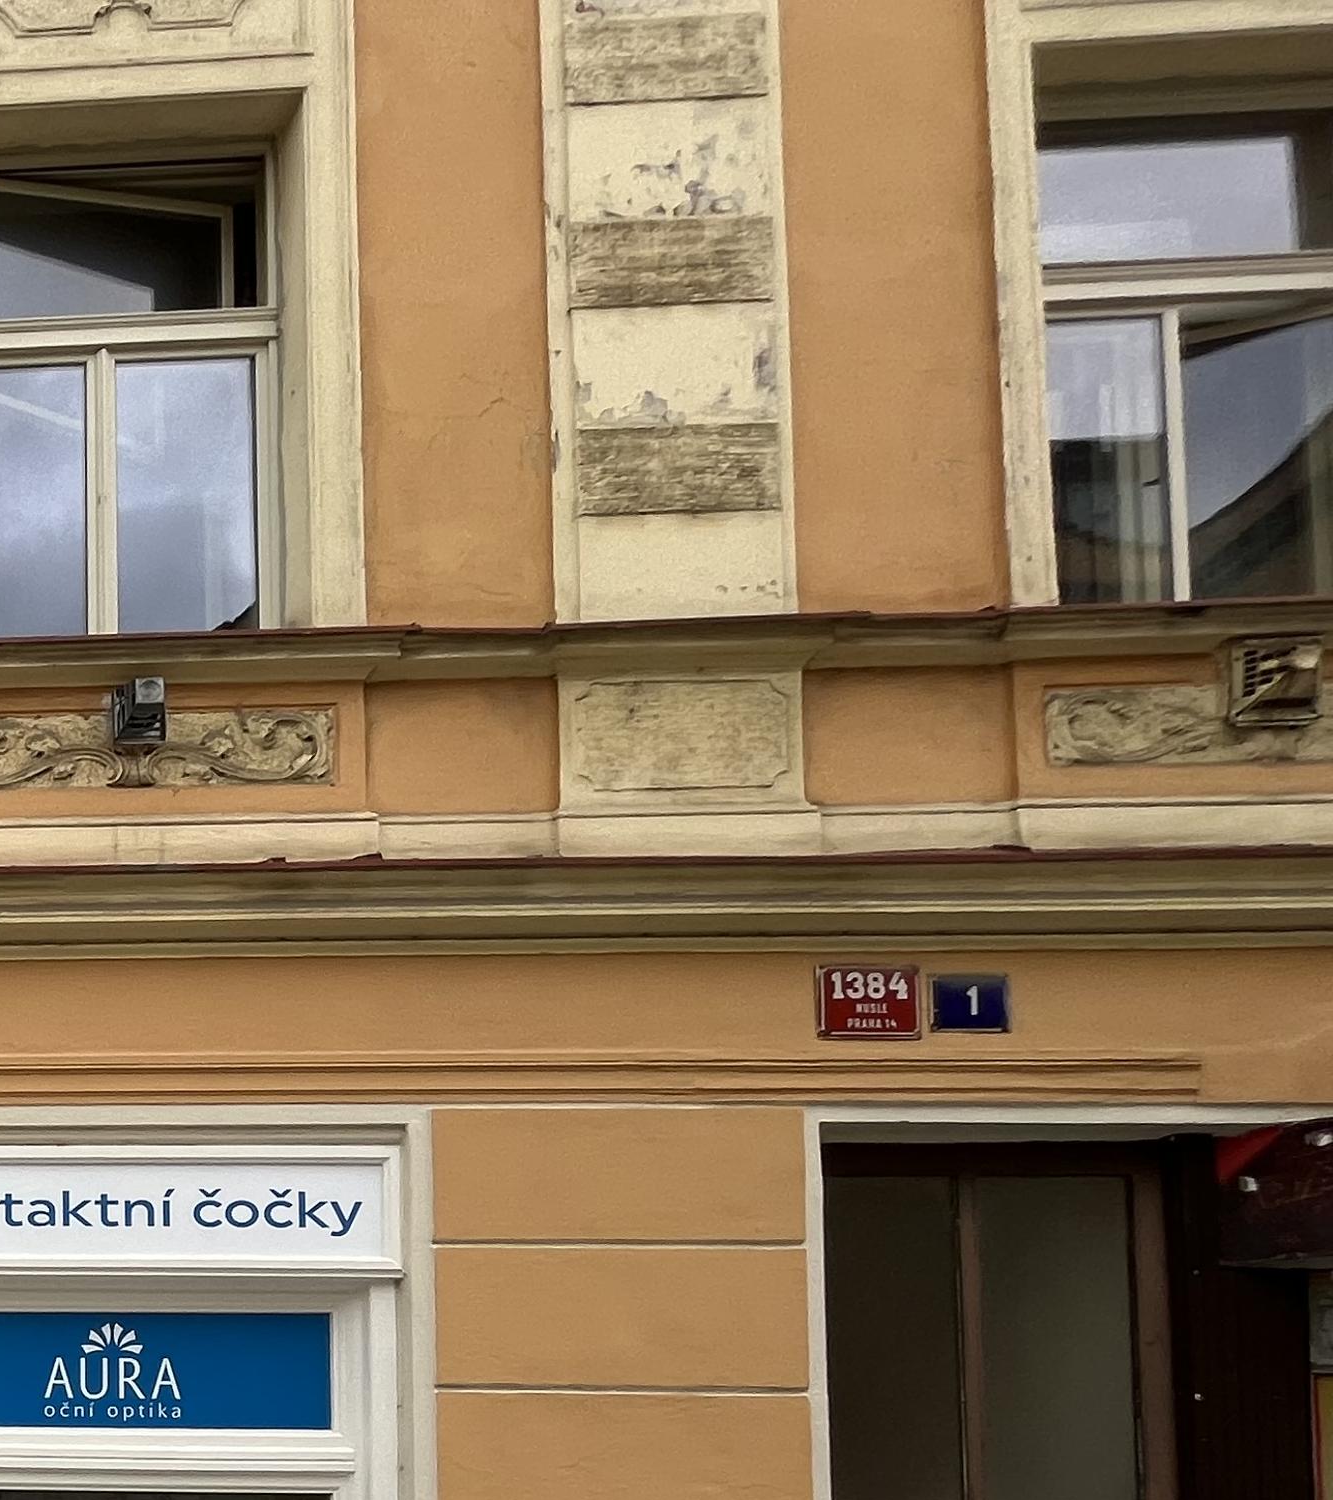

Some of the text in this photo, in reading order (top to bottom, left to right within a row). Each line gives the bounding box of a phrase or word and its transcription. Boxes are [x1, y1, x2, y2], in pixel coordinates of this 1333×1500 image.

[831, 972, 909, 999] 1384
[855, 1003, 888, 1014] NUSLE
[966, 986, 978, 1016] 1
[847, 1018, 882, 1028] PRAHA
[192, 1188, 363, 1238] čočky
[44, 1356, 181, 1400] AURA
[43, 1401, 182, 1422] oční optika
